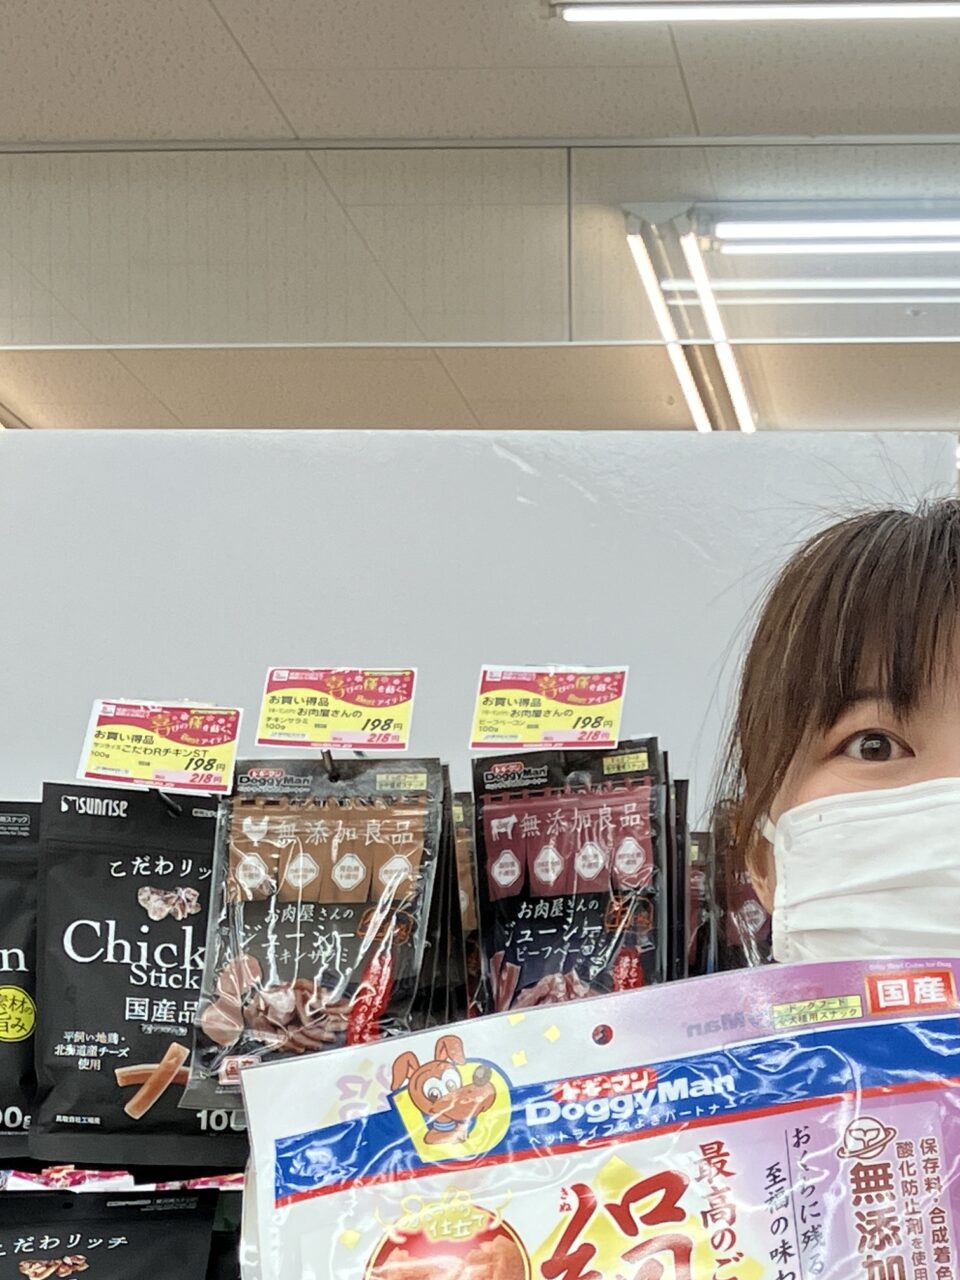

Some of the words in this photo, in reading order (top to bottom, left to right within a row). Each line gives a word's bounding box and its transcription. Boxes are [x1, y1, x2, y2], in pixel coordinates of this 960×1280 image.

[269, 695, 329, 707] お買い得品
[482, 696, 542, 708] お買い得品
[361, 718, 403, 731] 198円
[572, 716, 613, 730] 198円
[94, 730, 155, 745] お買い得品
[184, 757, 226, 772] 198円
[521, 803, 642, 838] 無添加良品
[877, 976, 948, 1008] 国産
[560, 1070, 650, 1101] ドギーマン
[526, 1073, 736, 1127] DoggyMan
